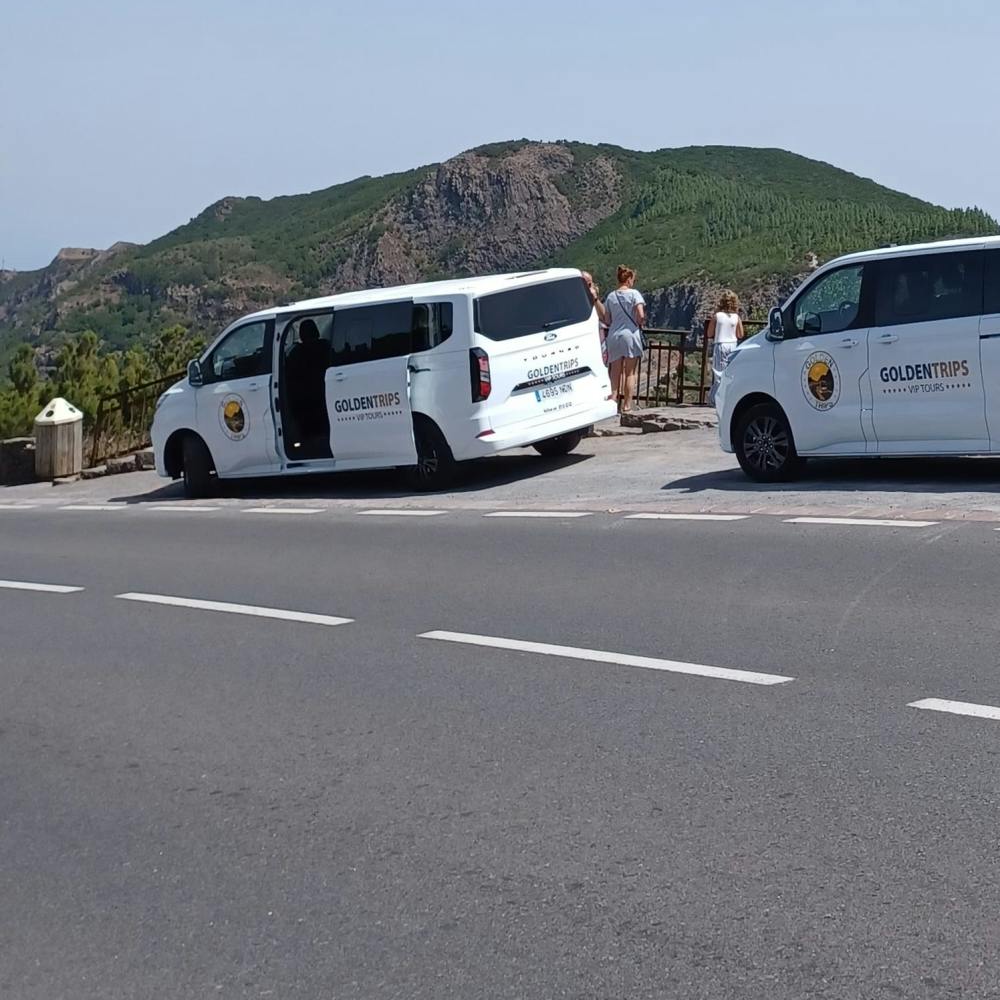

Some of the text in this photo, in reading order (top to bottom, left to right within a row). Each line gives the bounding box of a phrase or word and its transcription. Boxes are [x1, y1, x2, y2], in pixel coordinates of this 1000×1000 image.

[527, 358, 580, 379] GOLDENTRIPS
[879, 359, 970, 383] GOLDENTRIPS
[908, 382, 945, 394] VIP TOURS
[334, 392, 401, 413] GOLDENTRIPS
[365, 411, 384, 421] TOURS
